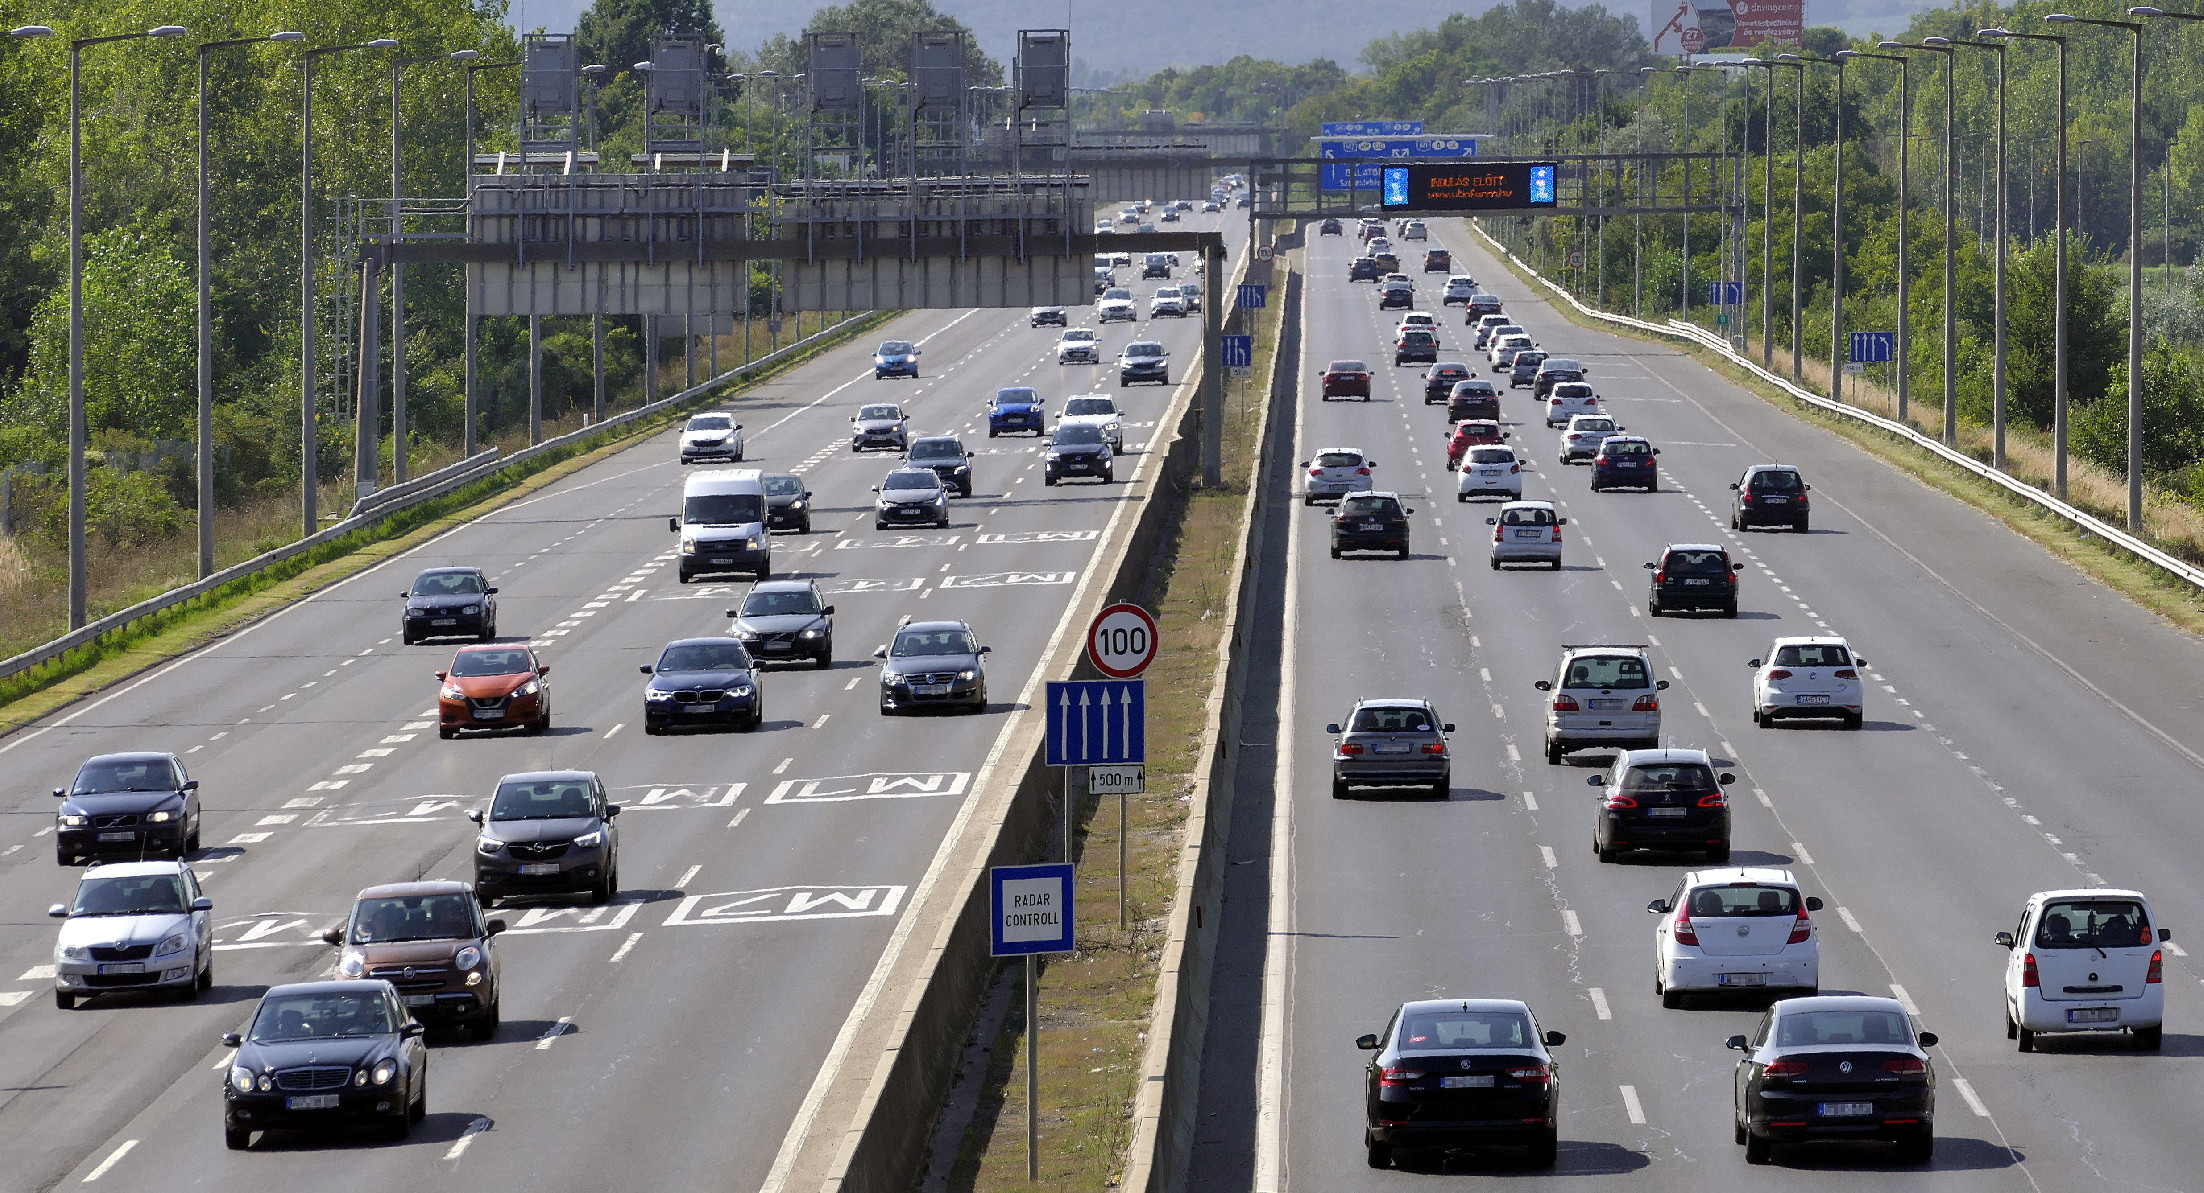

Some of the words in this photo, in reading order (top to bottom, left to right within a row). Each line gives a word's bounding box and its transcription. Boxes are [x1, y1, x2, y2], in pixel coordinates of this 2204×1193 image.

[1751, 3, 1800, 14] drivingcamp
[1100, 626, 1146, 656] 100
[1099, 772, 1121, 787] 500
[1124, 776, 1133, 786] m
[699, 889, 878, 918] M7
[1014, 893, 1051, 908] RADAR
[1005, 911, 1059, 927] CONTROLL
